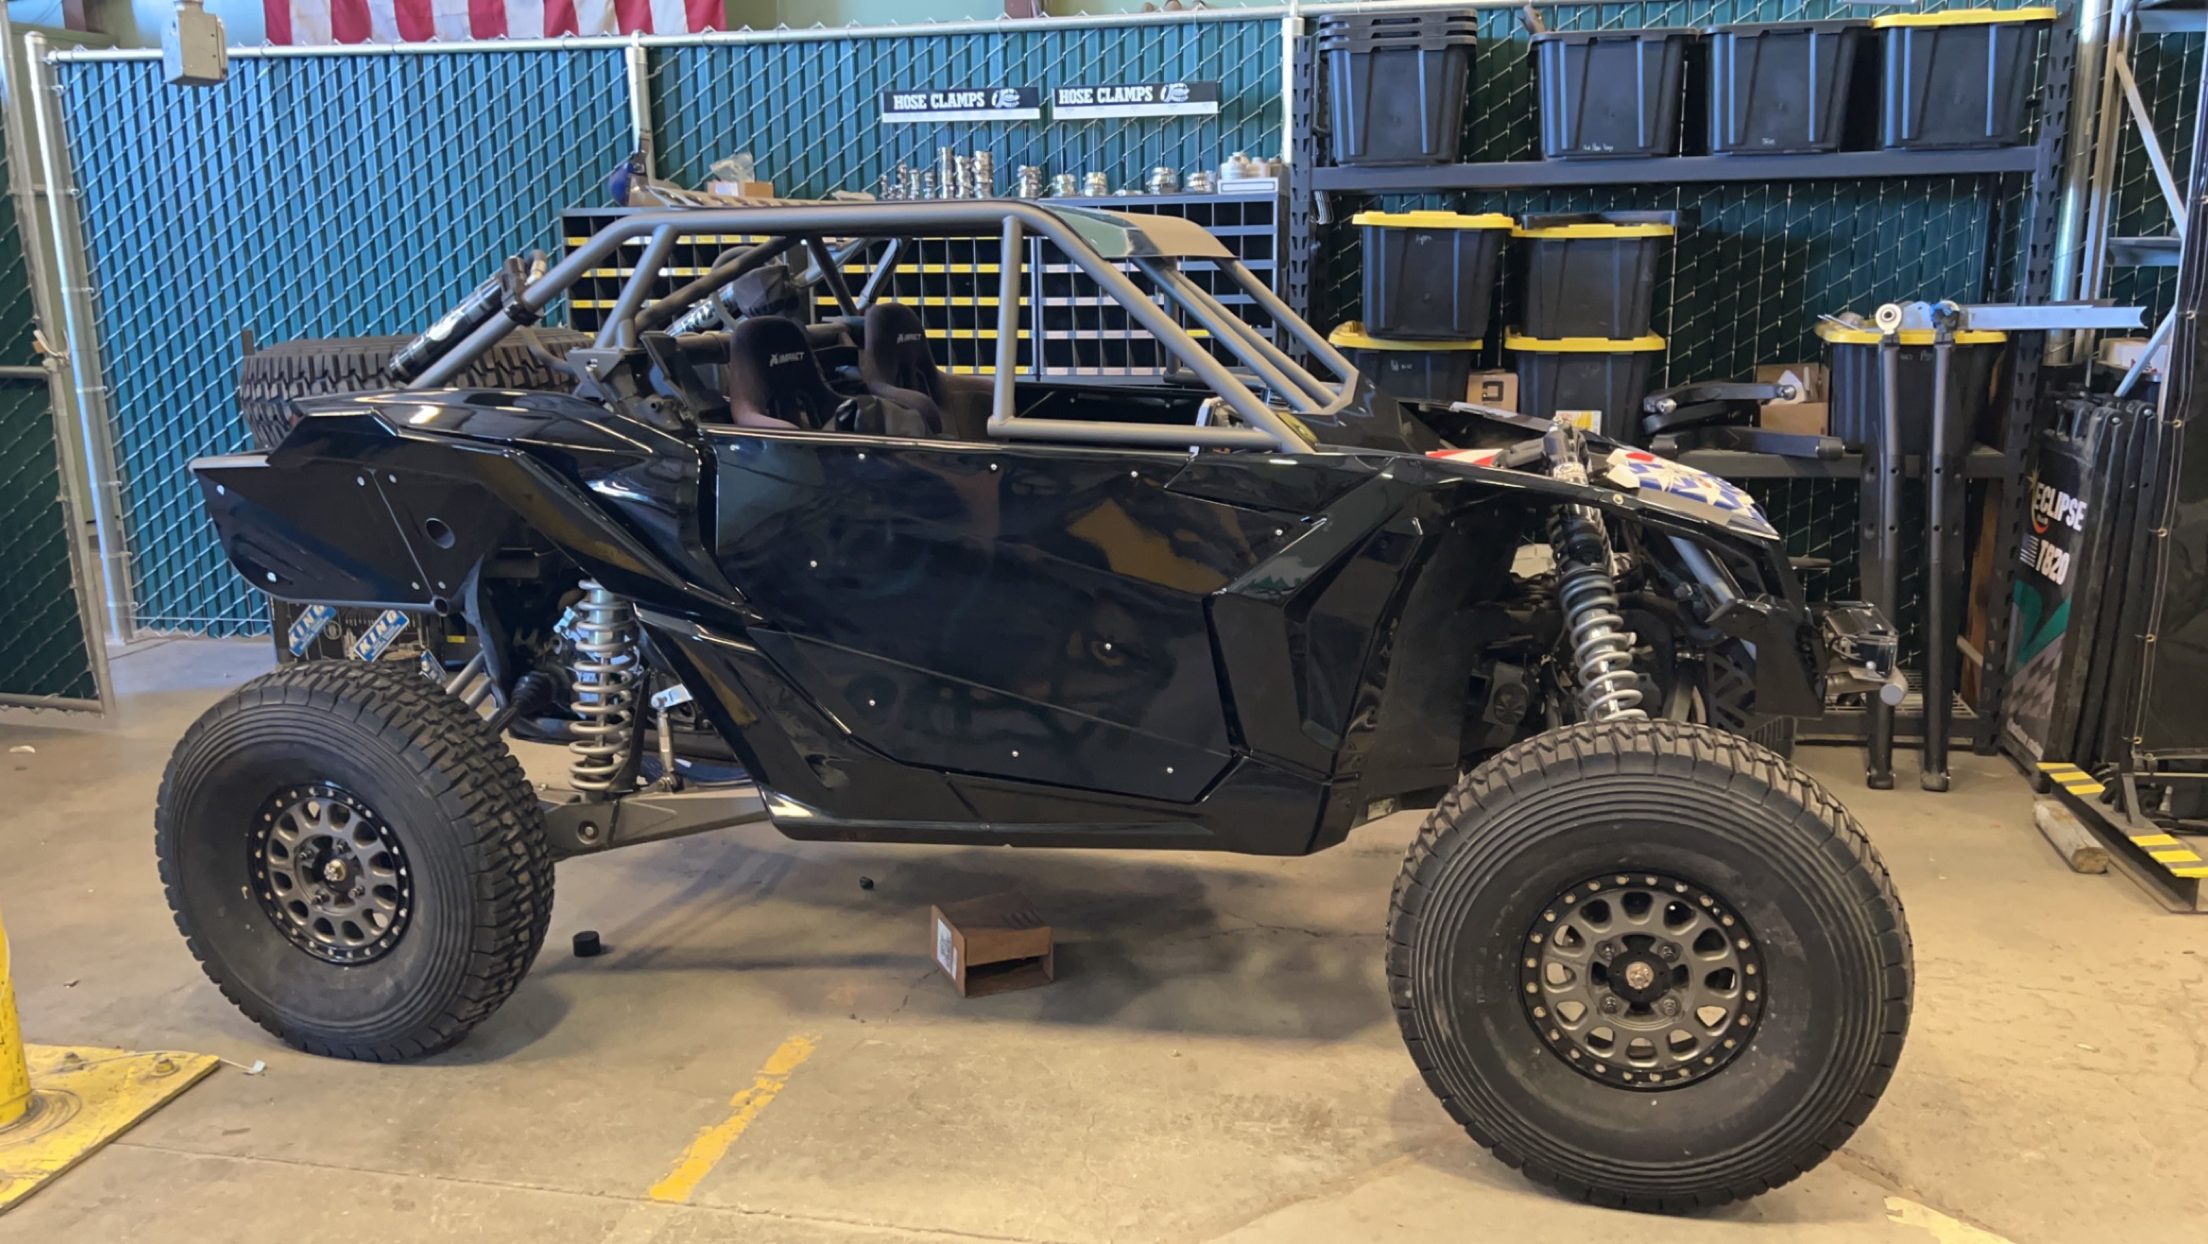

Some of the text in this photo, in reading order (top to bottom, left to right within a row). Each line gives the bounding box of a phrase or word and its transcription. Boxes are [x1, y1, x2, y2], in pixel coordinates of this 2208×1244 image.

[893, 91, 985, 110] HOSE CLAMPS
[1058, 85, 1154, 105] HOSE CLAMPS
[2035, 482, 2088, 532] ECLIPSE
[359, 609, 398, 655] KING
